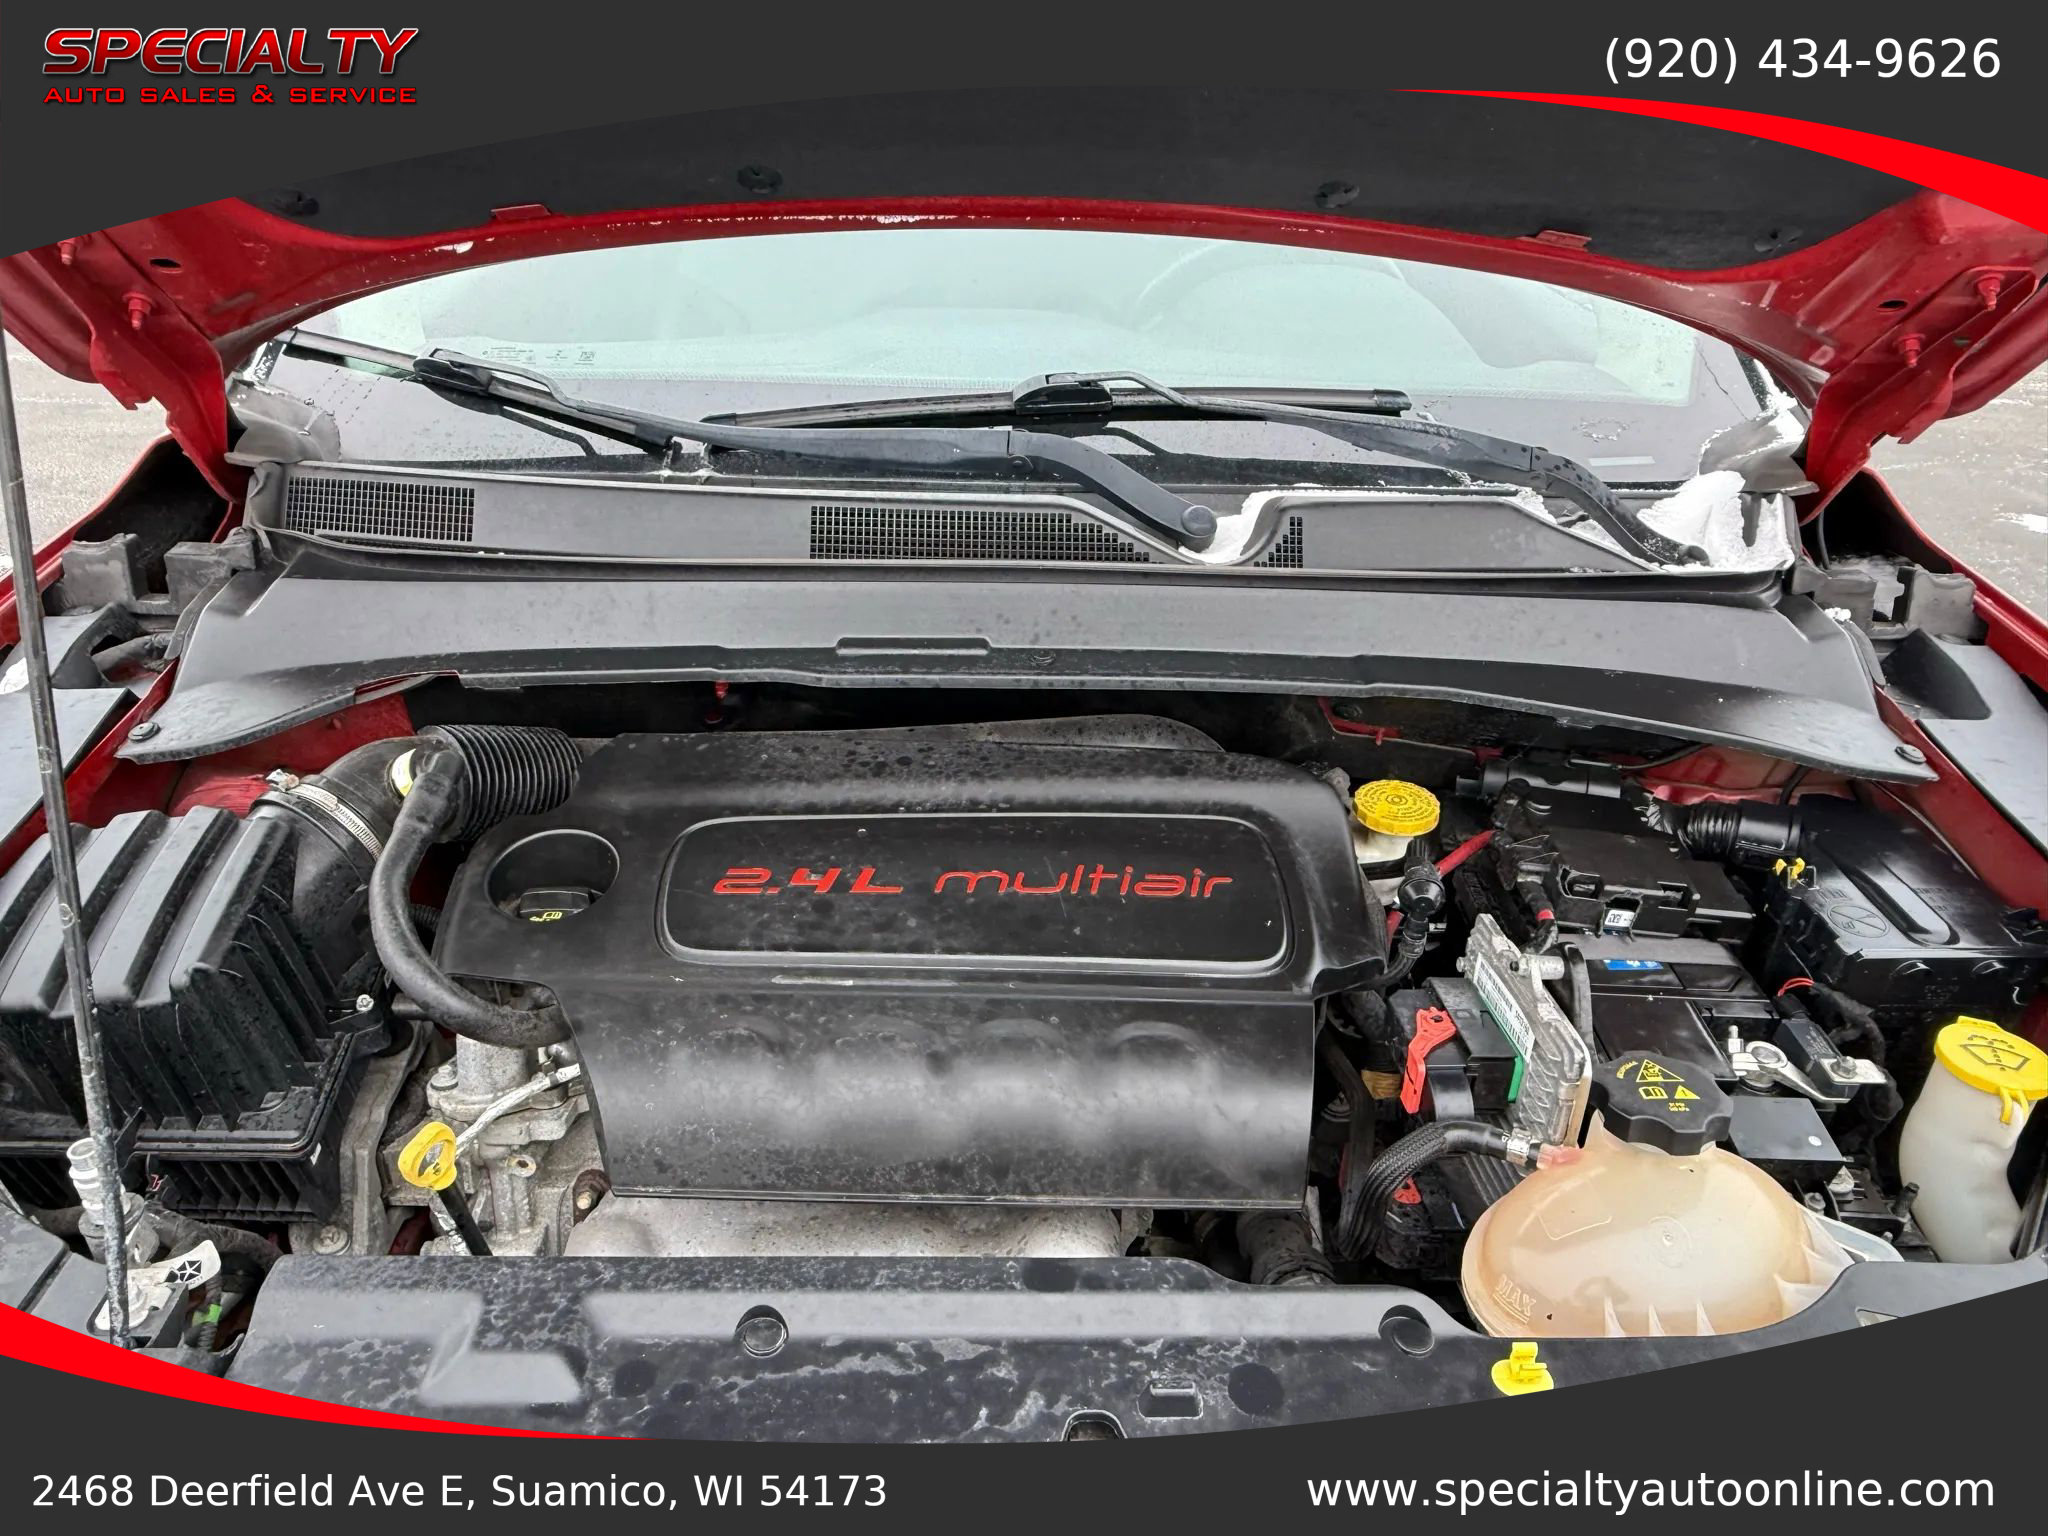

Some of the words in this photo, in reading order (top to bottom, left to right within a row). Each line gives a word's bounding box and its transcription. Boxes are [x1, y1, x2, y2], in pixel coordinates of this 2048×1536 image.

[713, 867, 903, 895] 2.4L
[935, 863, 1234, 898] multiair
[1495, 1273, 1537, 1316] MAX
